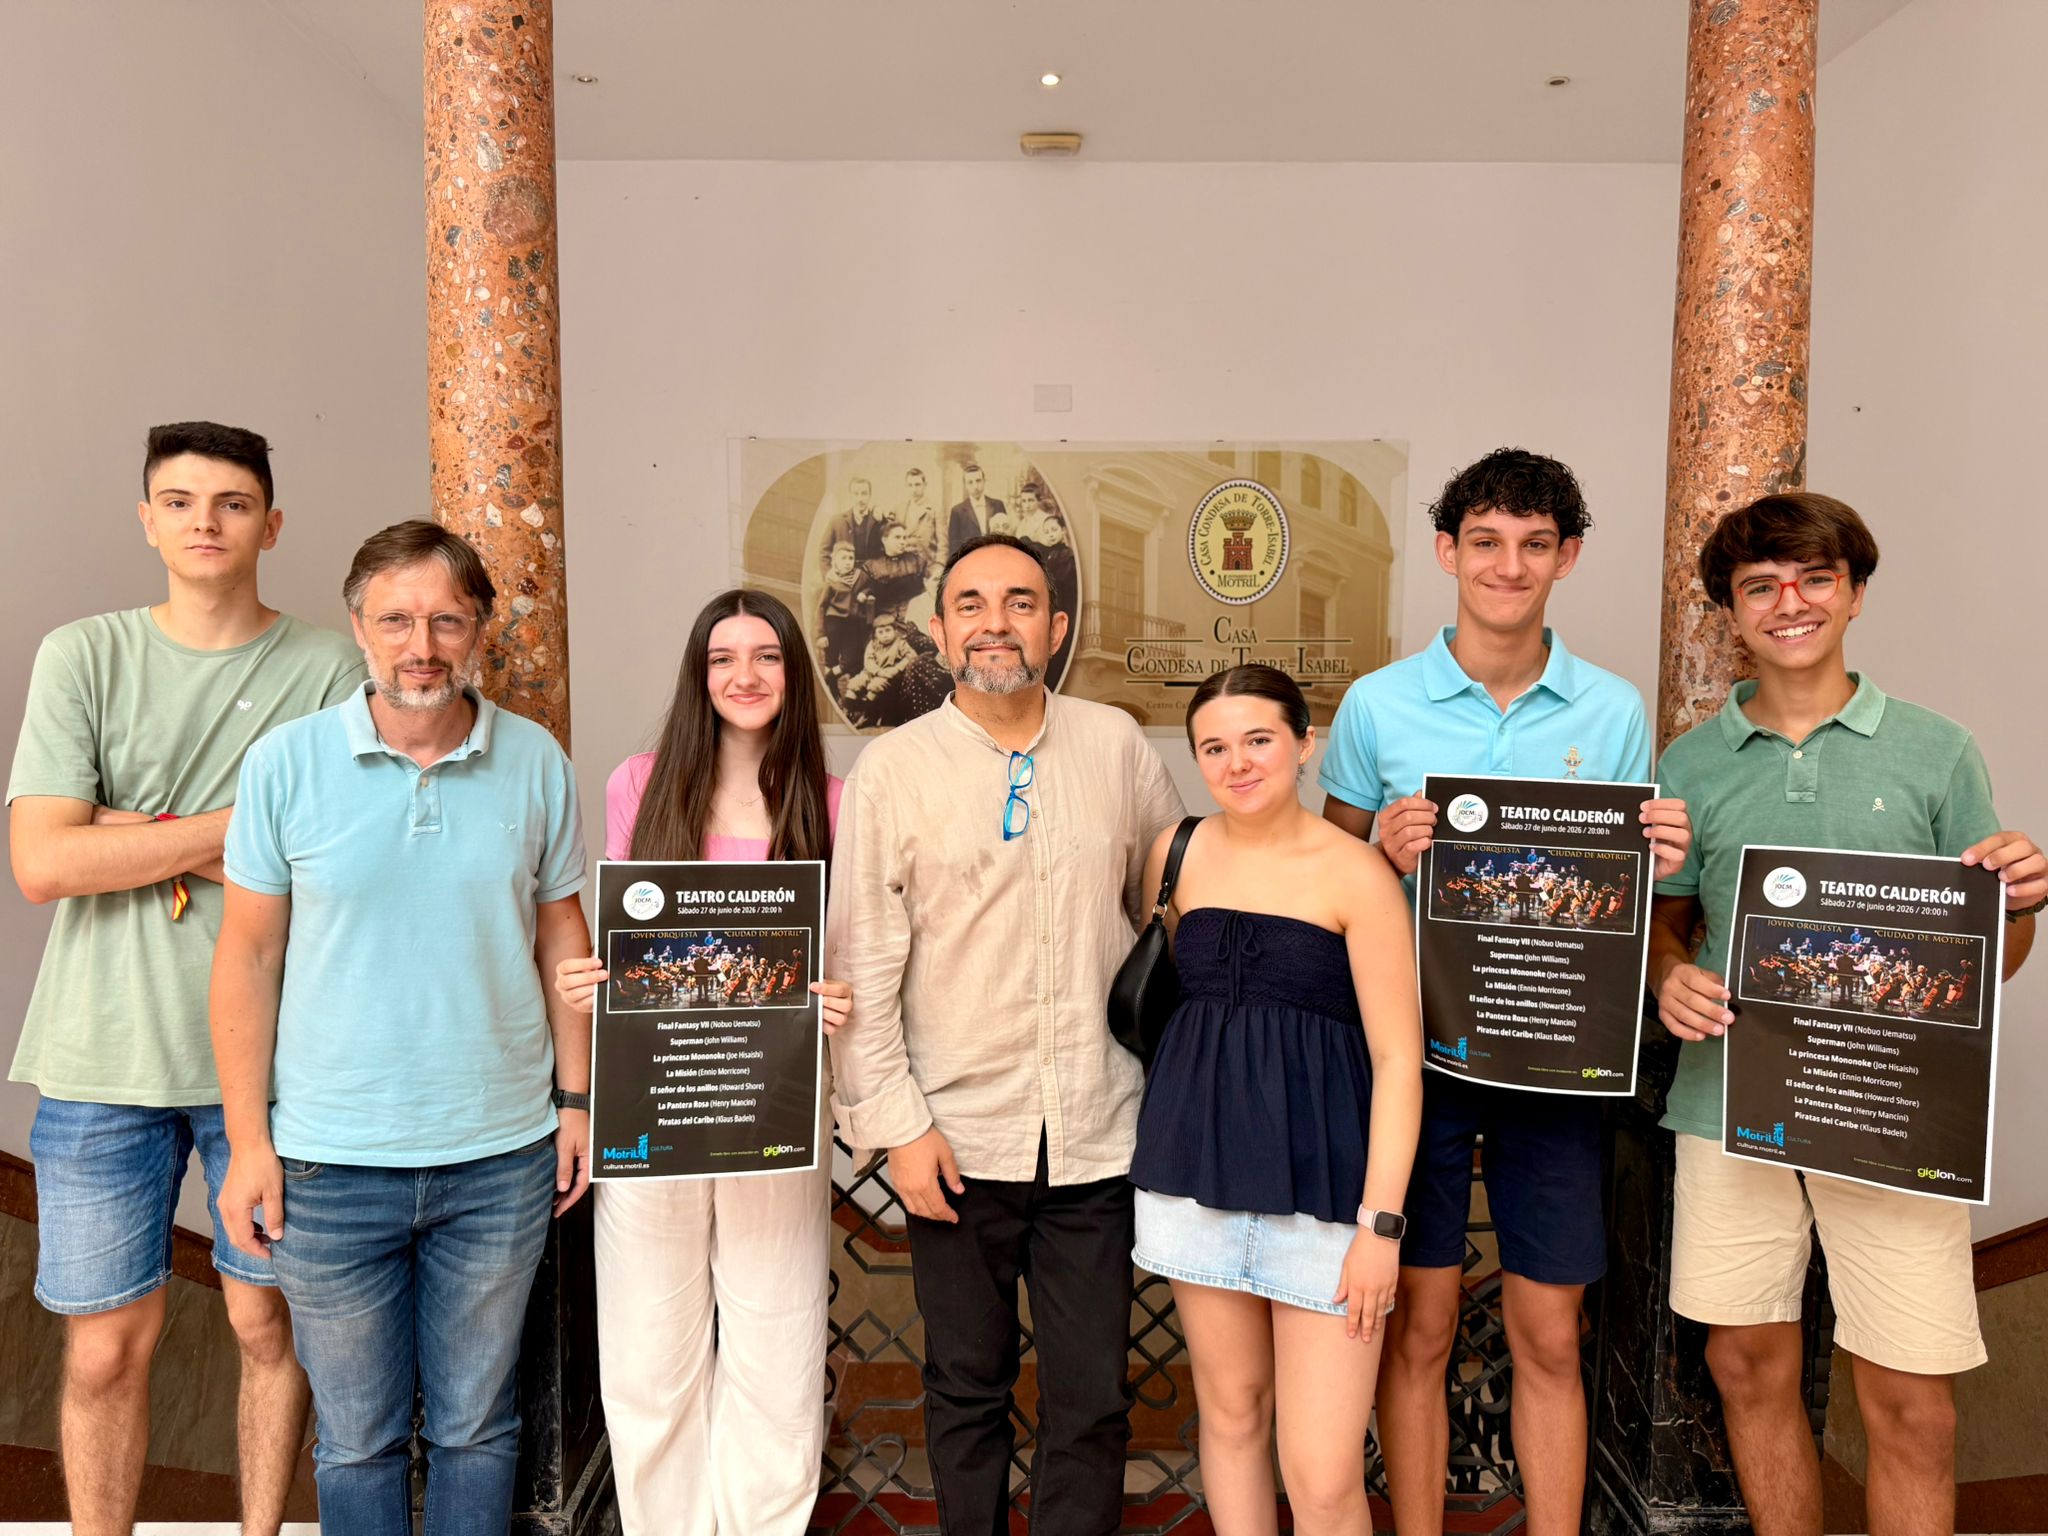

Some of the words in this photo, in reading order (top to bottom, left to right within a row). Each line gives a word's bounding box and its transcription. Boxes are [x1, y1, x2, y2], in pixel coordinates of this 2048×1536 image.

[1198, 497, 1231, 537] CONDESA
[1234, 493, 1248, 503] DE
[1210, 659, 1229, 673] DE
[1499, 805, 1550, 820] TEATRO
[1552, 808, 1624, 824] CALDERÓN
[1500, 822, 1523, 830] Sábado
[1541, 825, 1557, 833] junio
[1566, 825, 1582, 833] 2026
[1587, 827, 1605, 835] 20:00
[1453, 843, 1478, 852] JOVEN
[1479, 845, 1521, 855] ORQUESTA
[675, 890, 725, 903] TEATRO
[727, 887, 795, 903] CALDERÓN
[1819, 880, 1877, 897] TEATRO
[1879, 885, 1966, 905] CALDERÓN
[1820, 897, 1846, 907] Sábado
[1846, 900, 1856, 908] 27
[1866, 903, 1885, 911] junio
[1896, 904, 1914, 913] 2026
[1920, 906, 1942, 916] 20:00
[1767, 919, 1795, 929] JOVEN
[1796, 922, 1843, 933] ORQUESTA
[630, 931, 656, 939] JOVEN
[657, 931, 698, 939] ORQUESTA
[1477, 934, 1494, 942] Final
[1494, 935, 1520, 946] Fantasy
[1520, 937, 1530, 945] VII
[1530, 938, 1554, 947] (Nobuo
[1554, 940, 1584, 950] Uematsu)
[1916, 933, 1929, 942] DE
[1489, 951, 1524, 960] Superman
[1524, 954, 1541, 962] (John
[1541, 955, 1570, 964] Williams)
[1472, 964, 1480, 972] La
[1481, 966, 1510, 974] princesa
[1510, 967, 1546, 978] Mononoke
[1546, 971, 1559, 979] (Joe
[1559, 972, 1586, 981] Hisaishi)
[1493, 981, 1517, 990] Misión
[1517, 984, 1537, 992] (Ennio
[1537, 985, 1571, 995] Morricone)
[1468, 994, 1476, 1002] El
[1475, 995, 1495, 1004] señor
[1495, 997, 1505, 1005] de
[1504, 998, 1515, 1006] los
[1515, 999, 1538, 1008] anillos
[1538, 1001, 1565, 1010] (Howard
[1565, 1003, 1586, 1012] Shore)
[1476, 1010, 1484, 1018] La
[1485, 1011, 1511, 1021] Pantera
[1511, 1014, 1528, 1022] Rosa
[1528, 1016, 1549, 1026] (Henry
[1550, 1017, 1577, 1027] Mancini)
[1476, 1025, 1500, 1035] Piratas
[1500, 1028, 1511, 1036] del
[1511, 1029, 1533, 1038] Caribe
[1534, 1032, 1553, 1040] (Klaus
[1553, 1033, 1575, 1043] Badelt)
[1793, 1017, 1811, 1026] Final
[1812, 1019, 1842, 1032] Fantasy
[1842, 1023, 1853, 1032] VII
[1854, 1025, 1881, 1036] (Nobuo
[1882, 1029, 1916, 1041] Uematsu)
[1807, 1035, 1846, 1047] Superman
[1846, 1041, 1866, 1050] (John
[1866, 1043, 1900, 1055] Williams)
[1788, 1048, 1797, 1056] La
[1798, 1051, 1830, 1061] princesa
[1830, 1054, 1872, 1067] Mononoke
[1872, 1061, 1887, 1070] (Joe
[1888, 1063, 1919, 1075] Hisaishi)
[1581, 1067, 1624, 1078] giglon.com
[1803, 1066, 1812, 1074] La
[1812, 1067, 1838, 1078] Misión
[1839, 1072, 1862, 1082] (Ennio
[1862, 1075, 1902, 1088] Morricone)
[1785, 1078, 1793, 1086] El
[1793, 1081, 1814, 1090] señor
[1815, 1084, 1825, 1092] de
[1825, 1085, 1837, 1094] los
[1837, 1089, 1863, 1098] anillos
[1864, 1092, 1895, 1103] (Howard
[1895, 1096, 1920, 1108] Shore)
[1803, 1097, 1833, 1109] Pantera
[1834, 1103, 1852, 1112] Rosa
[1853, 1107, 1877, 1118] (Henry
[1877, 1110, 1909, 1122] Mancini)
[1794, 1111, 1820, 1122] Piratas
[1820, 1116, 1833, 1124] del
[1834, 1118, 1859, 1129] Caribe
[1859, 1123, 1881, 1133] (Klaus
[1882, 1127, 1908, 1138] Badelt)
[763, 1144, 806, 1157] giglon.com
[1917, 1167, 1973, 1184] giglon.com
